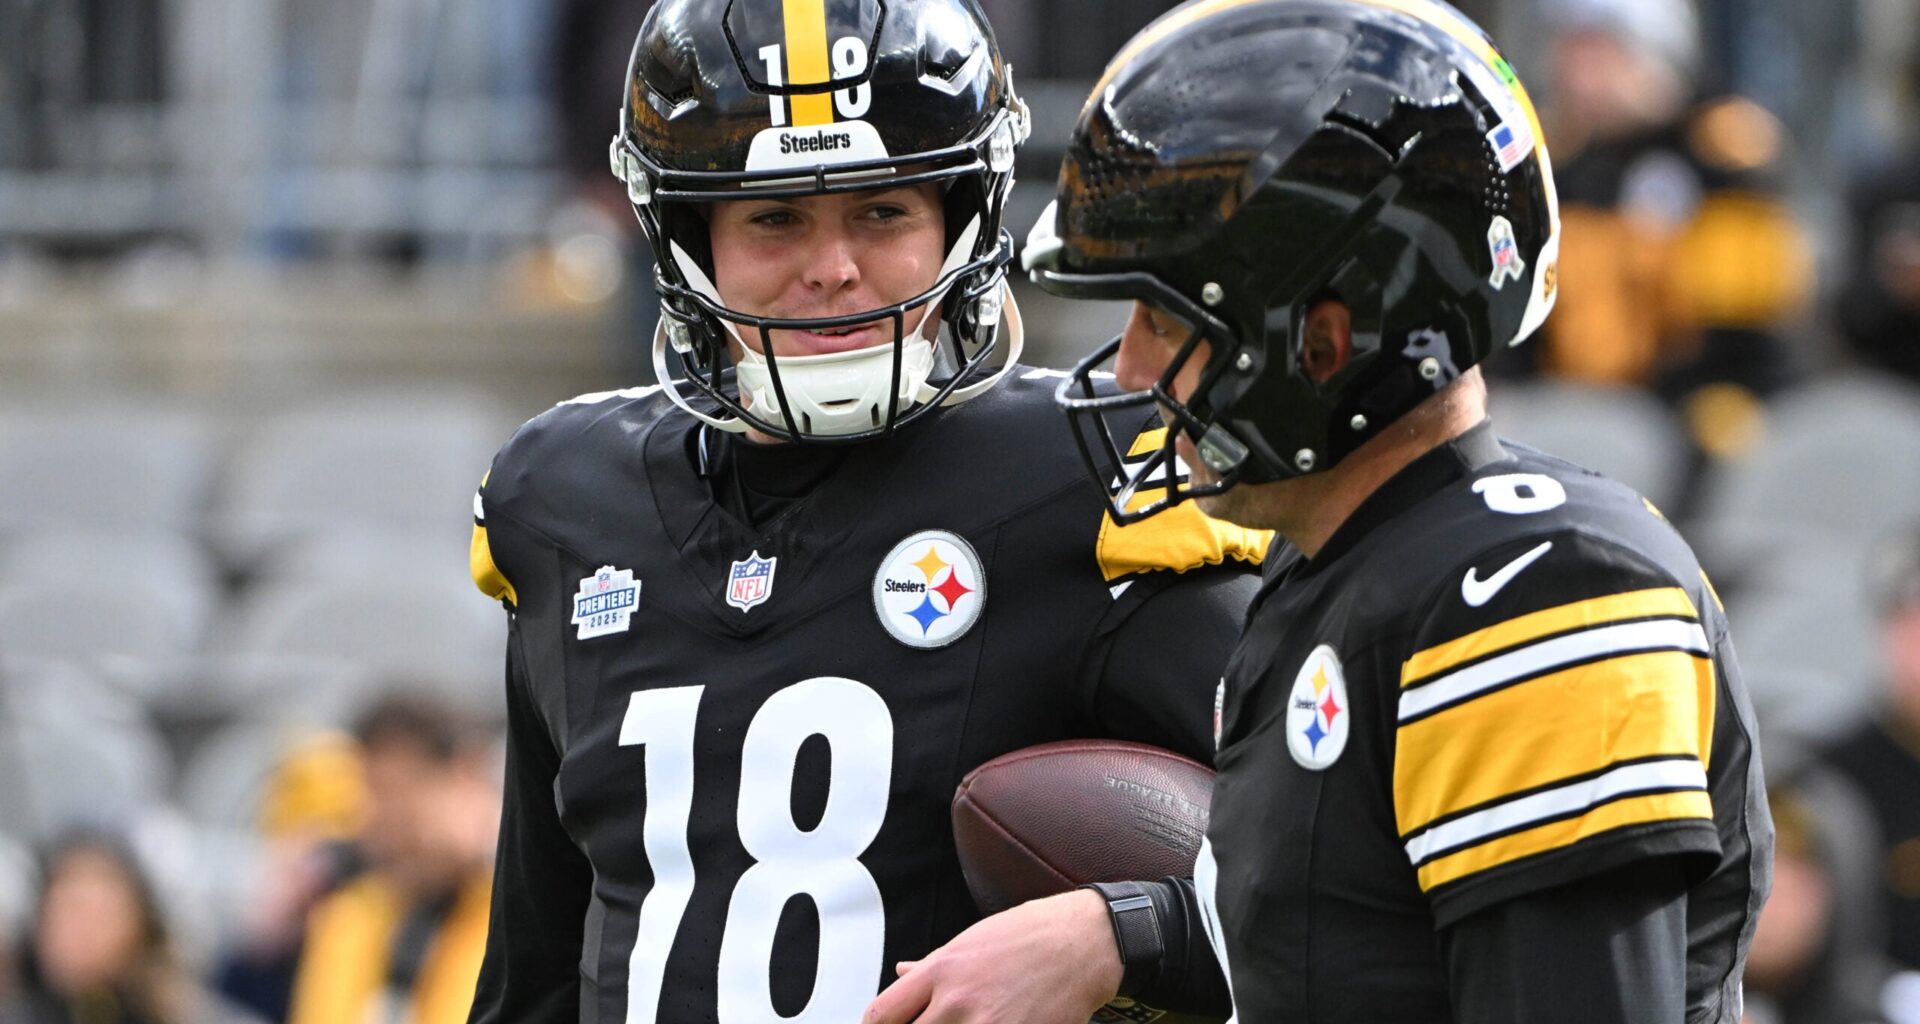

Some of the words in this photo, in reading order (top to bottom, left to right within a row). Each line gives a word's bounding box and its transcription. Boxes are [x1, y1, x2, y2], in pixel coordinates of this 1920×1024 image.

[758, 36, 872, 127] 18
[779, 130, 851, 154] Steelers
[733, 577, 763, 599] NFL
[884, 578, 926, 593] Steelers
[618, 676, 894, 1024] 18
